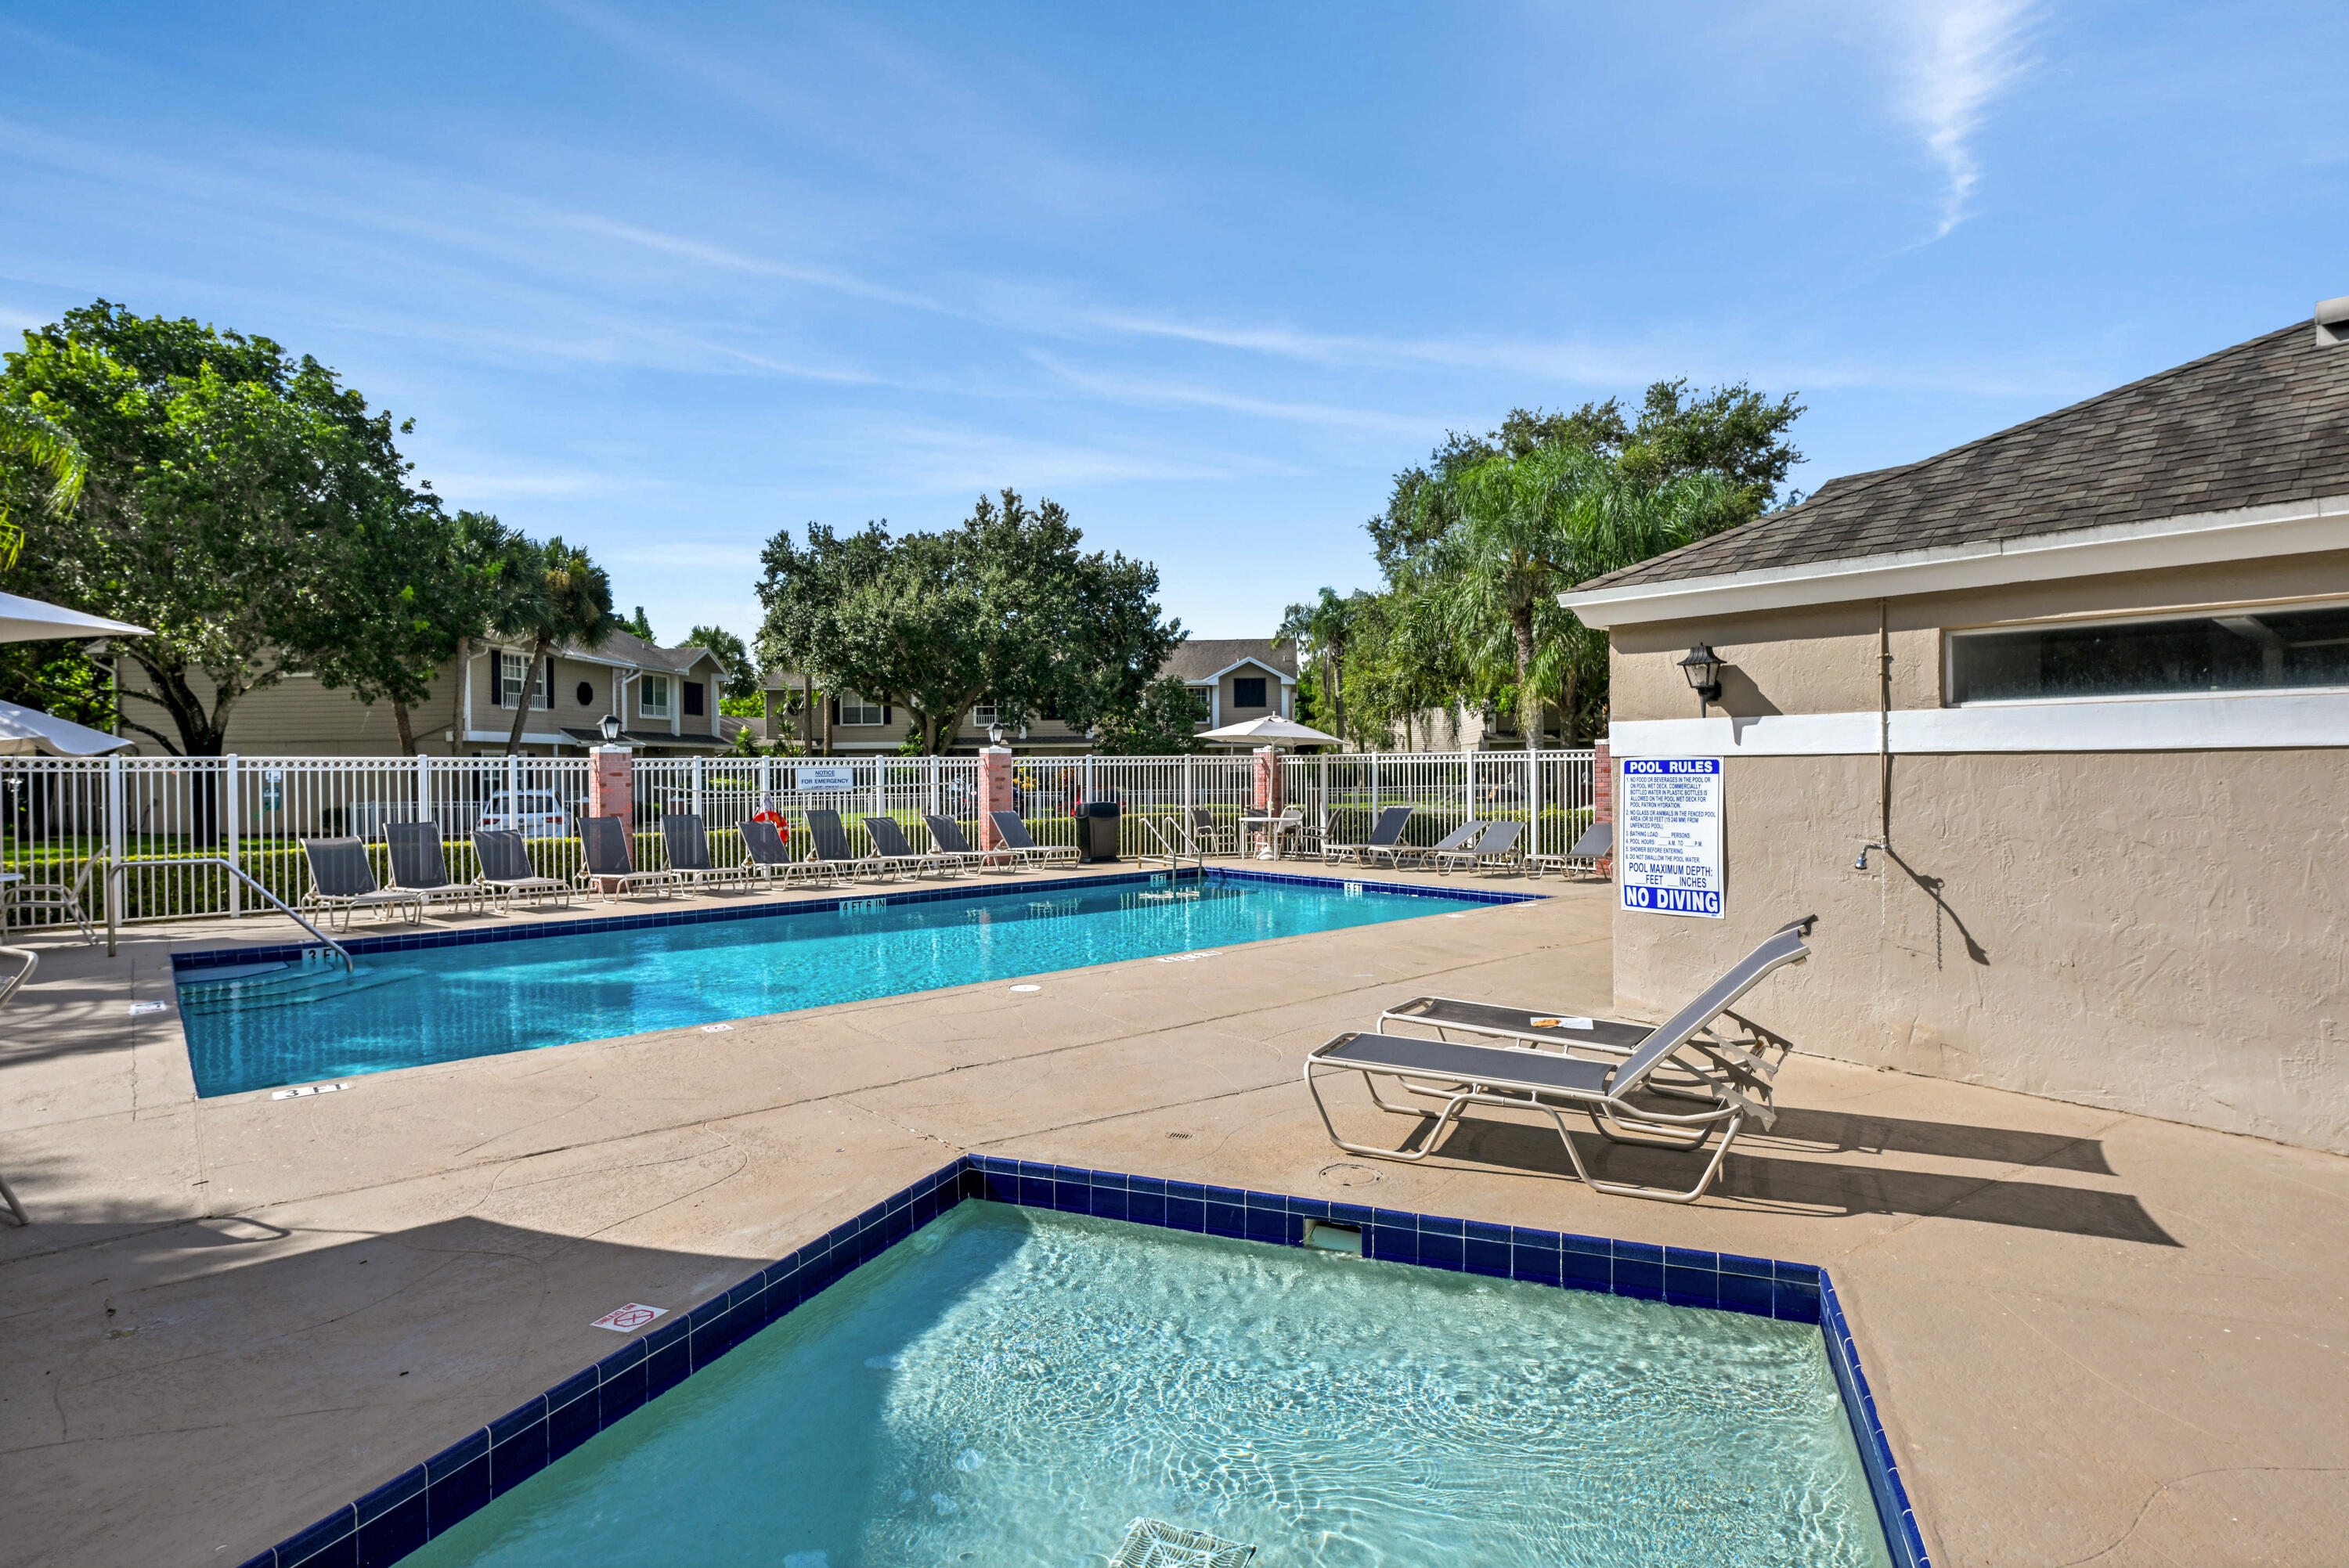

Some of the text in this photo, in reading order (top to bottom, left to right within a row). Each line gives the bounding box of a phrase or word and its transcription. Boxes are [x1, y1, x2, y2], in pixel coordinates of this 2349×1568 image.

[1629, 761, 1713, 773] POOL RULES
[1629, 862, 1713, 877] POOL MAXIMUM DEPTH:
[1646, 874, 1707, 888] FEET INCHES
[843, 899, 885, 910] 4 FT 6 IN
[1626, 886, 1718, 913] NO DIVING
[312, 1083, 342, 1094] FT
[594, 1310, 624, 1325] DIVING
